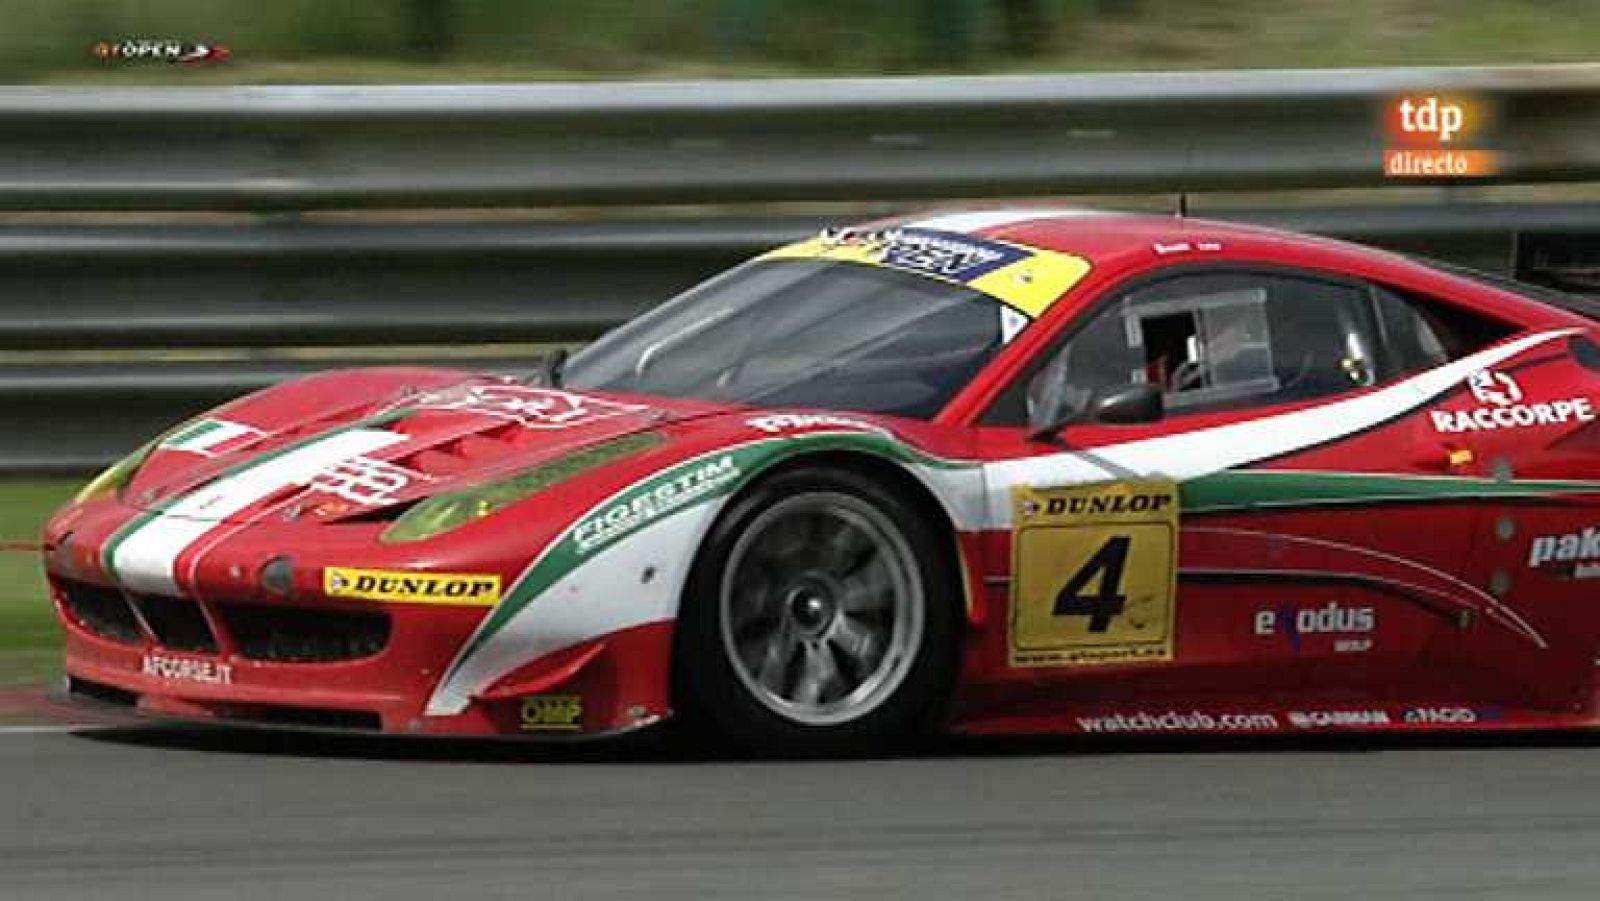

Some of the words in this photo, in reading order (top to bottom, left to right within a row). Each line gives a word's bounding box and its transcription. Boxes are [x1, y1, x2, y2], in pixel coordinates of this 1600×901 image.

[1431, 397, 1595, 433] RACCORPE
[1048, 494, 1172, 515] DUNLOP
[354, 575, 494, 597] DUNLOP
[1053, 535, 1132, 633] 4
[521, 696, 582, 724] OMP
[1076, 710, 1278, 733] watchclub.com
